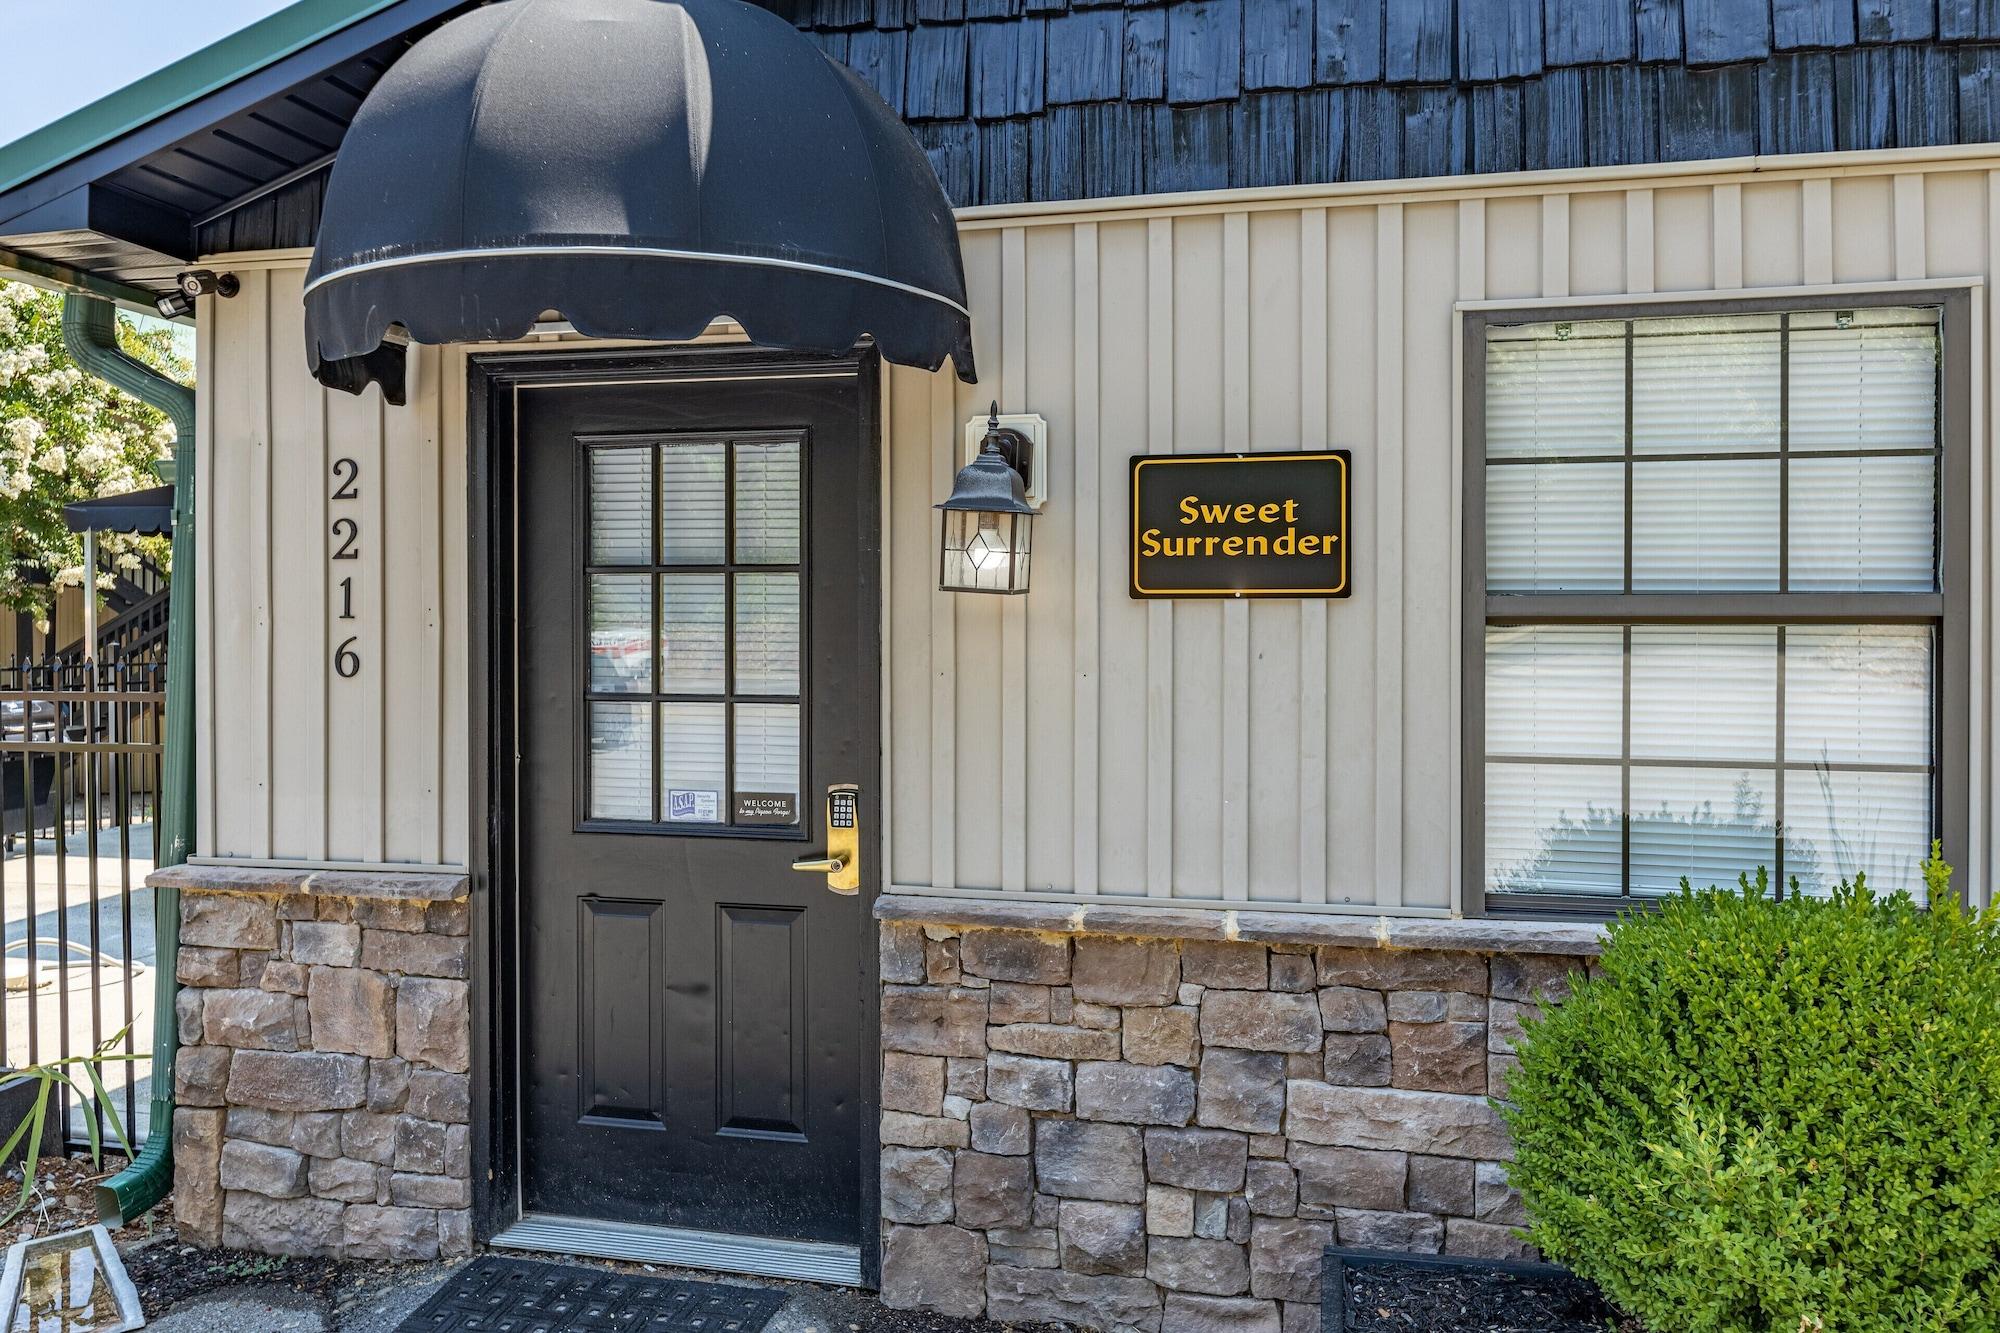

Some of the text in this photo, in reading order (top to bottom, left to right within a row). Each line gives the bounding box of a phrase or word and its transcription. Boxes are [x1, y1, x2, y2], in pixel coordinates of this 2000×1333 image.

[1179, 495, 1299, 525] Sweet
[1141, 527, 1339, 557] Surrender
[331, 457, 360, 678] 2216
[743, 799, 787, 808] WELCOME
